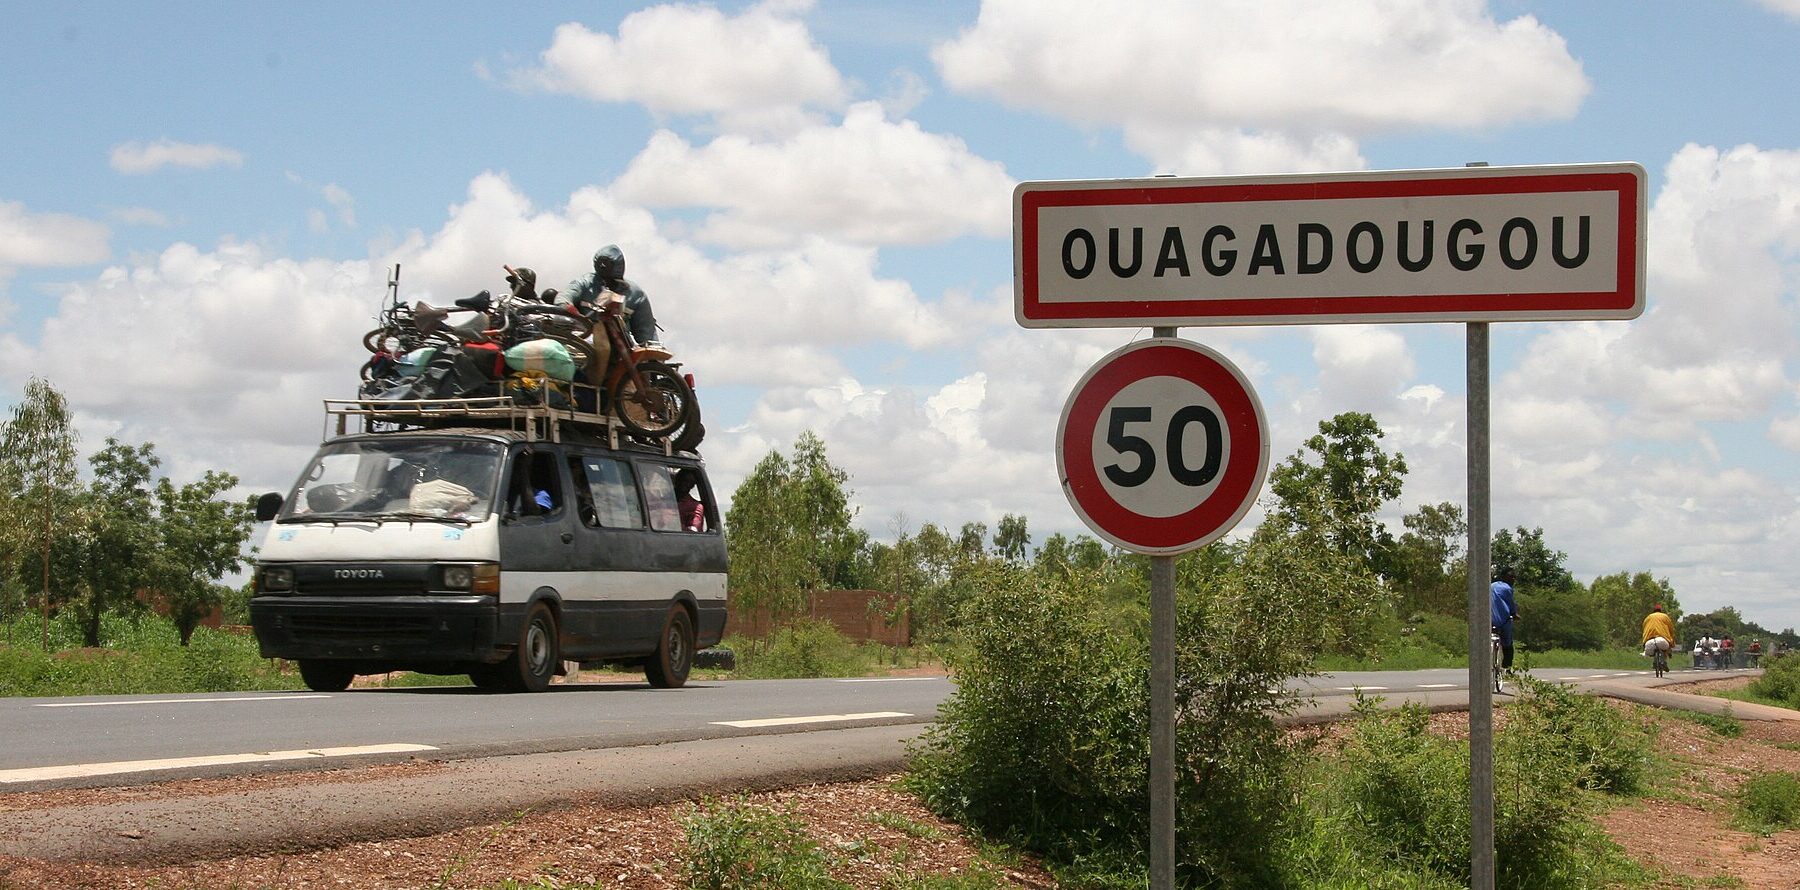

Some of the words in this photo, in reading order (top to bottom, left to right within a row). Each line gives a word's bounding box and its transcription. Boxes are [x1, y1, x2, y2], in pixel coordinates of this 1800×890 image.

[1061, 215, 1591, 280] OUAGADOUGOU
[1103, 404, 1223, 488] 50
[334, 569, 384, 579] TOYOTA
